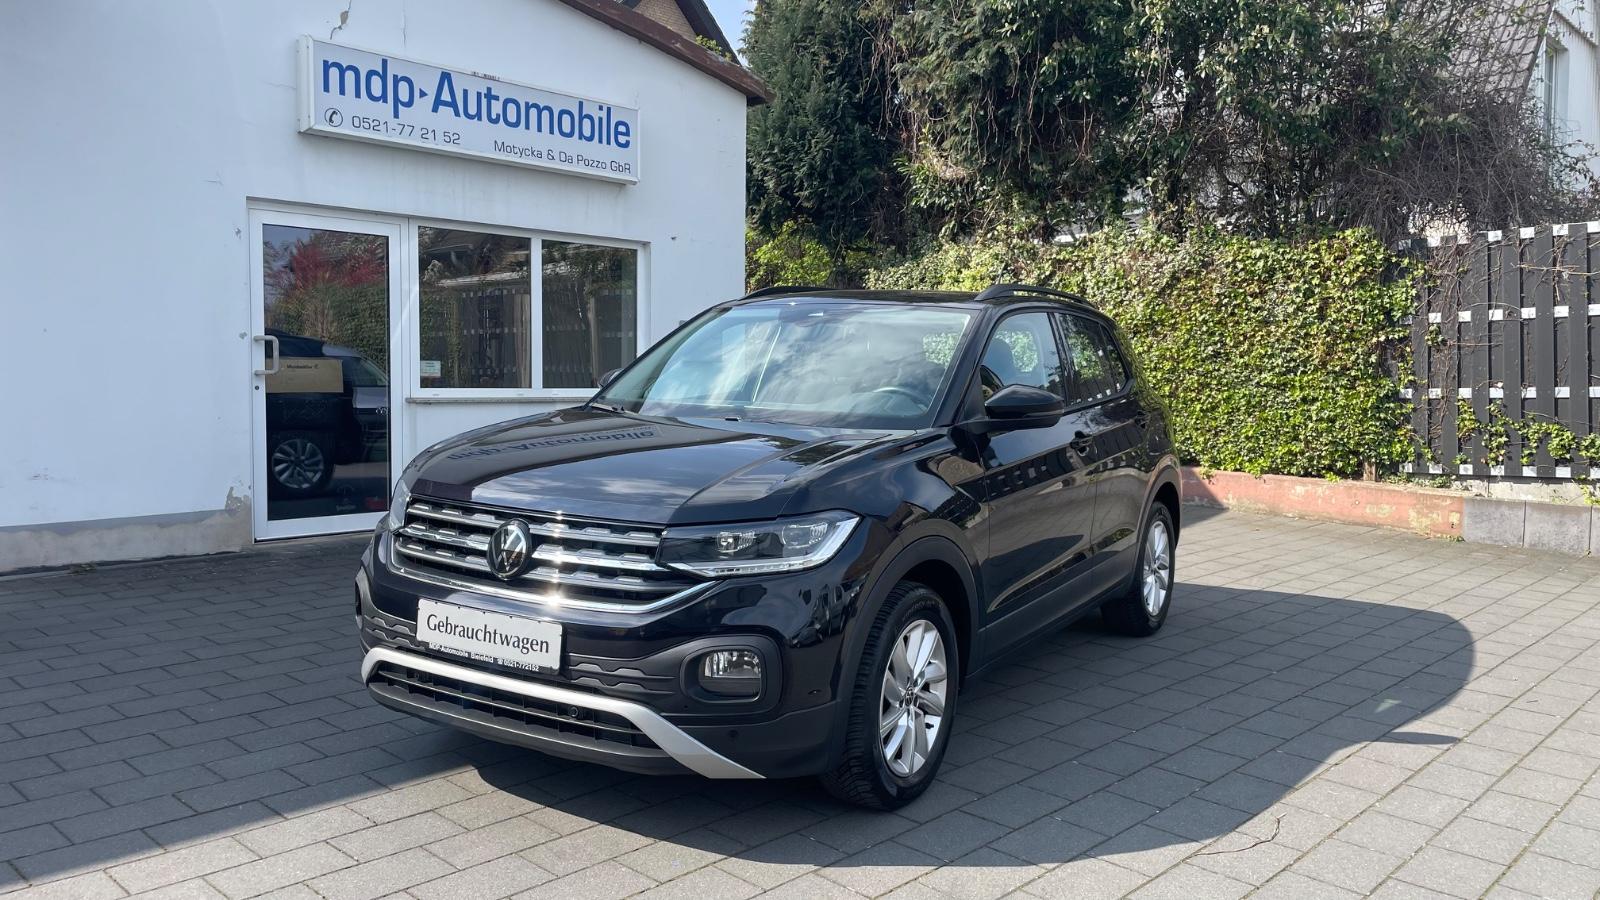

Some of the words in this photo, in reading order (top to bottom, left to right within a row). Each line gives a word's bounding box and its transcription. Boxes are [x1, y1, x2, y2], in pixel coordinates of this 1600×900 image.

[352, 115, 415, 137] 0521-77
[420, 128, 437, 142] 21
[443, 131, 461, 145] 52
[494, 140, 543, 159] Motycka
[547, 149, 556, 161] &
[559, 151, 574, 164] Da
[577, 155, 607, 170] Pozzo
[610, 160, 632, 174] GbR
[426, 614, 549, 655] Gebrauchtwagen
